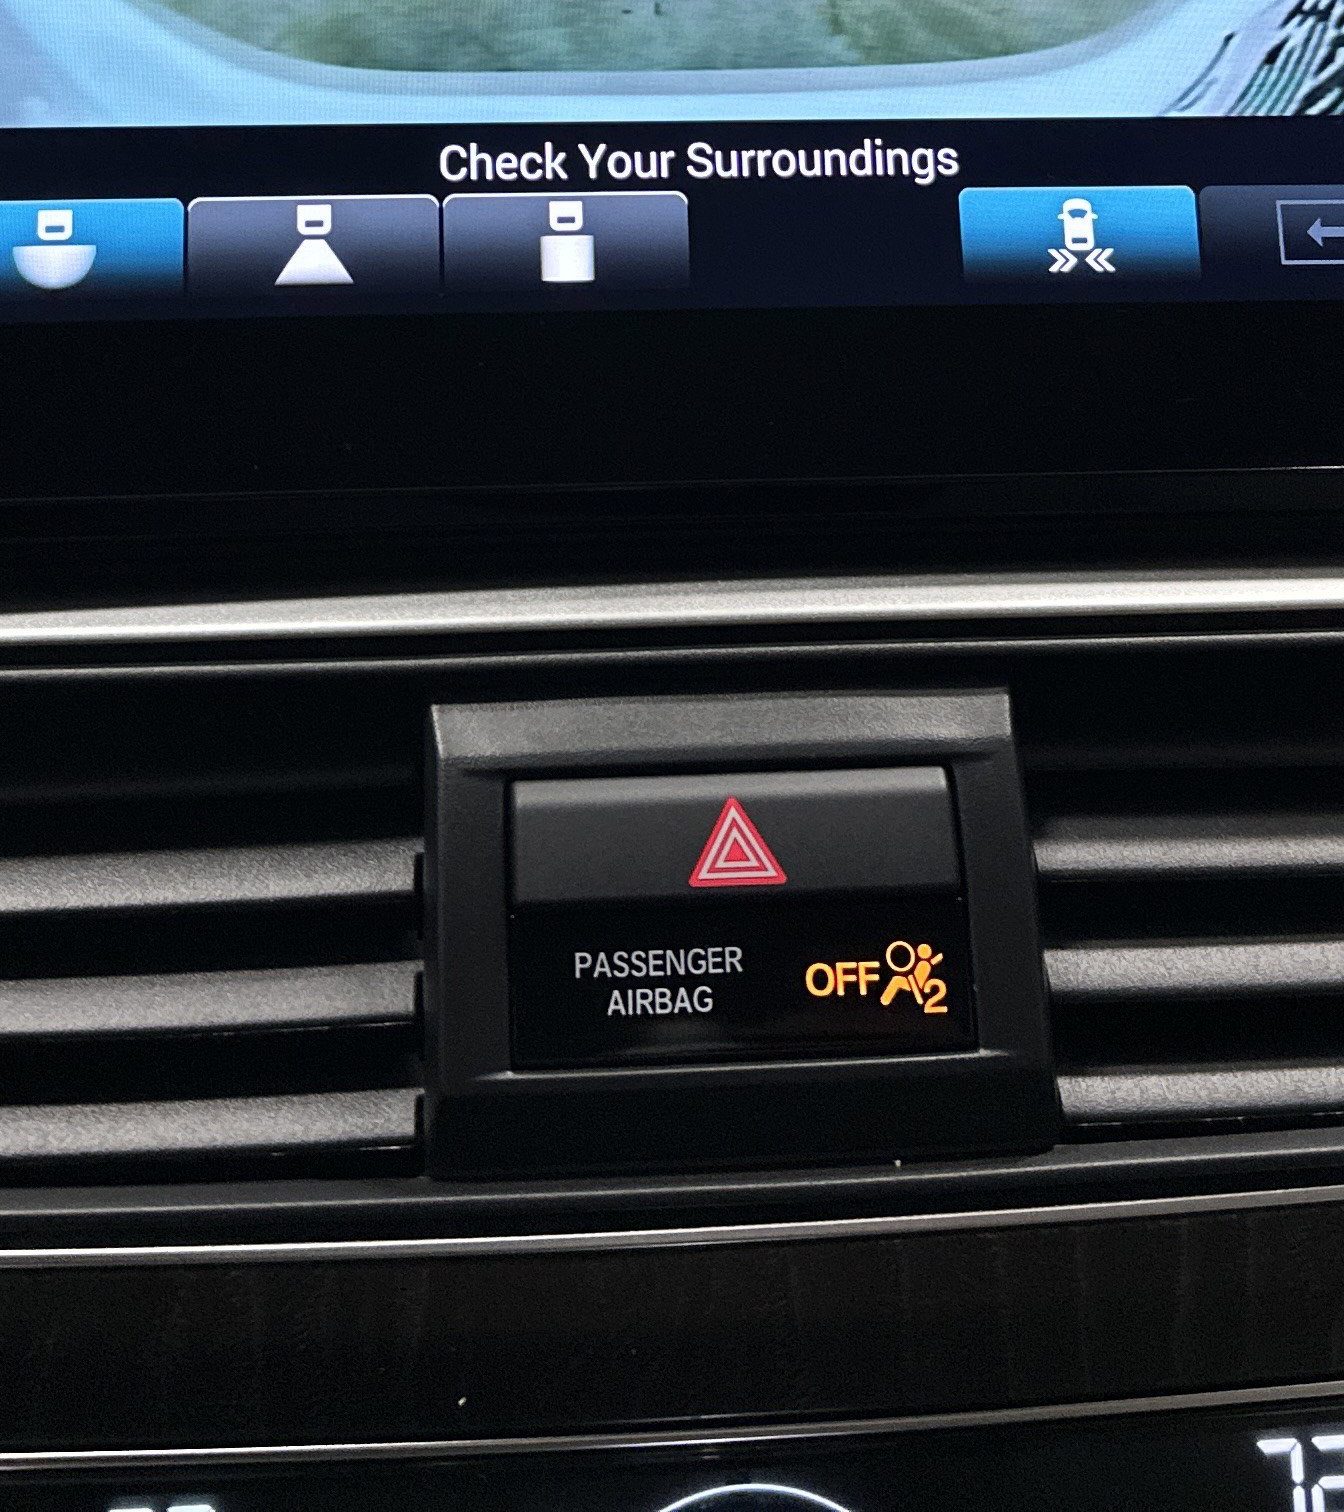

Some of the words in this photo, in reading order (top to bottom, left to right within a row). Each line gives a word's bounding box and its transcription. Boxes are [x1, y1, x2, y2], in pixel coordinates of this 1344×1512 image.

[439, 142, 568, 181] Check
[578, 142, 675, 180] Your
[685, 138, 960, 185] Surroundings
[573, 945, 744, 979] PASSENGER
[805, 961, 881, 998] OFF
[607, 985, 714, 1017] AIRBAG
